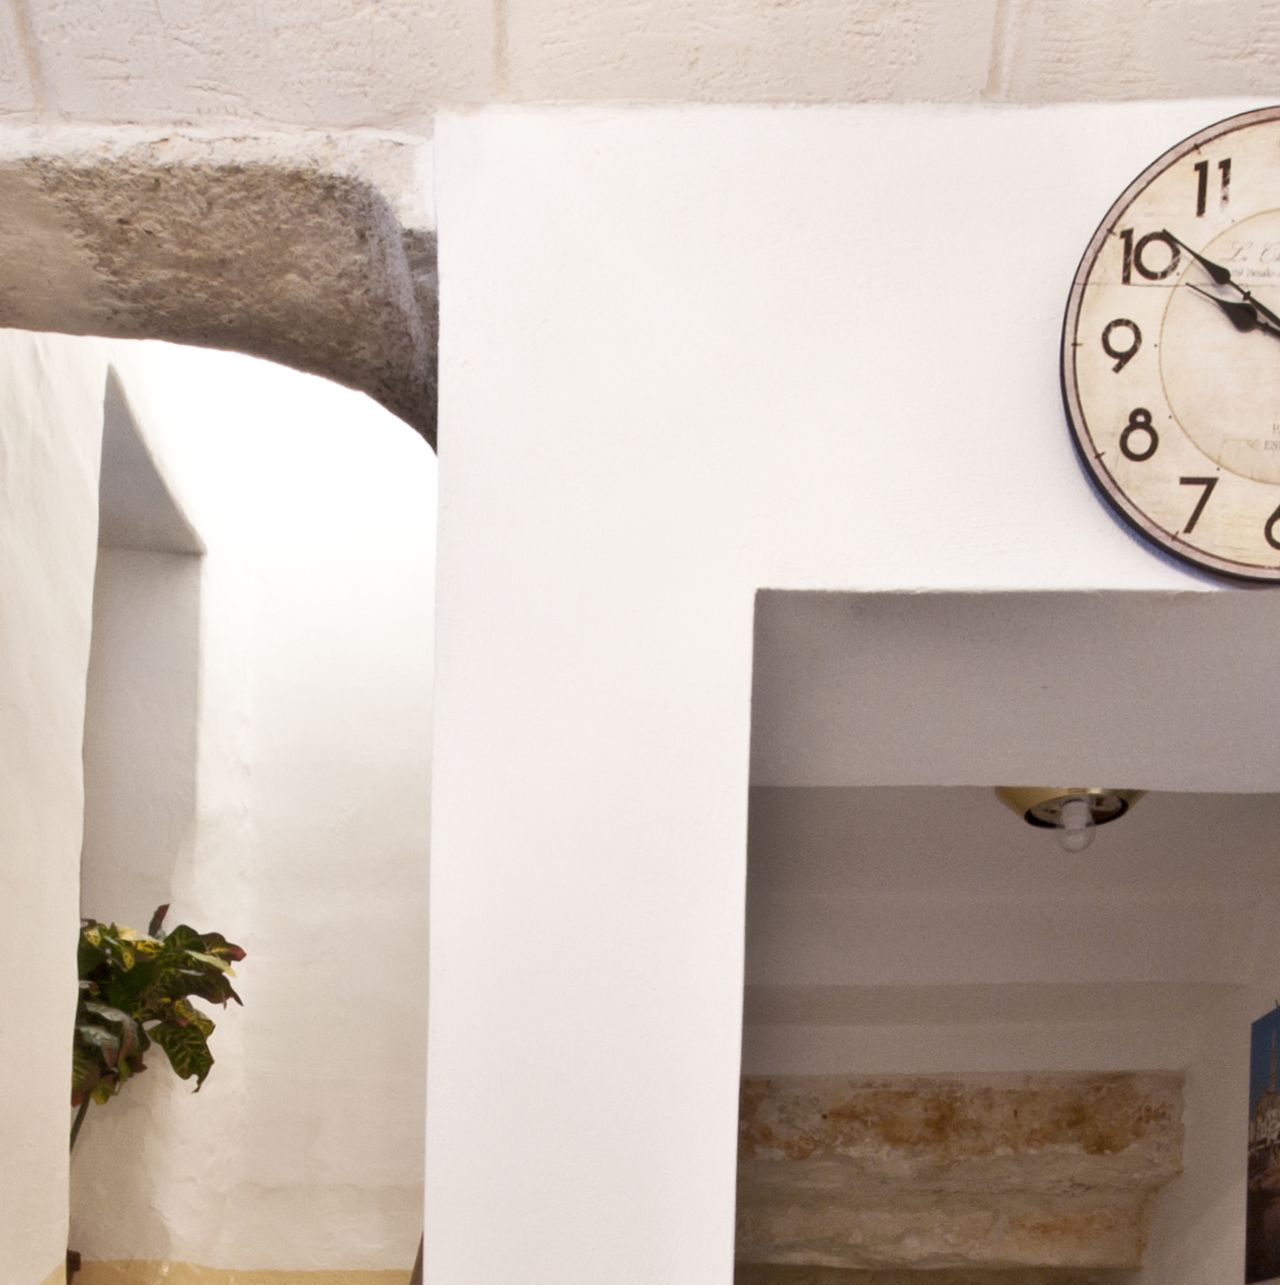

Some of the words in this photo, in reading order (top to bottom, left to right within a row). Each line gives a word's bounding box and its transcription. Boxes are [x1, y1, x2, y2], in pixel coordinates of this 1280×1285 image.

[1194, 157, 1232, 218] 11
[1119, 228, 1181, 286] 10
[1101, 318, 1142, 374] 9
[1119, 407, 1159, 462] 8
[1179, 477, 1219, 534] 7
